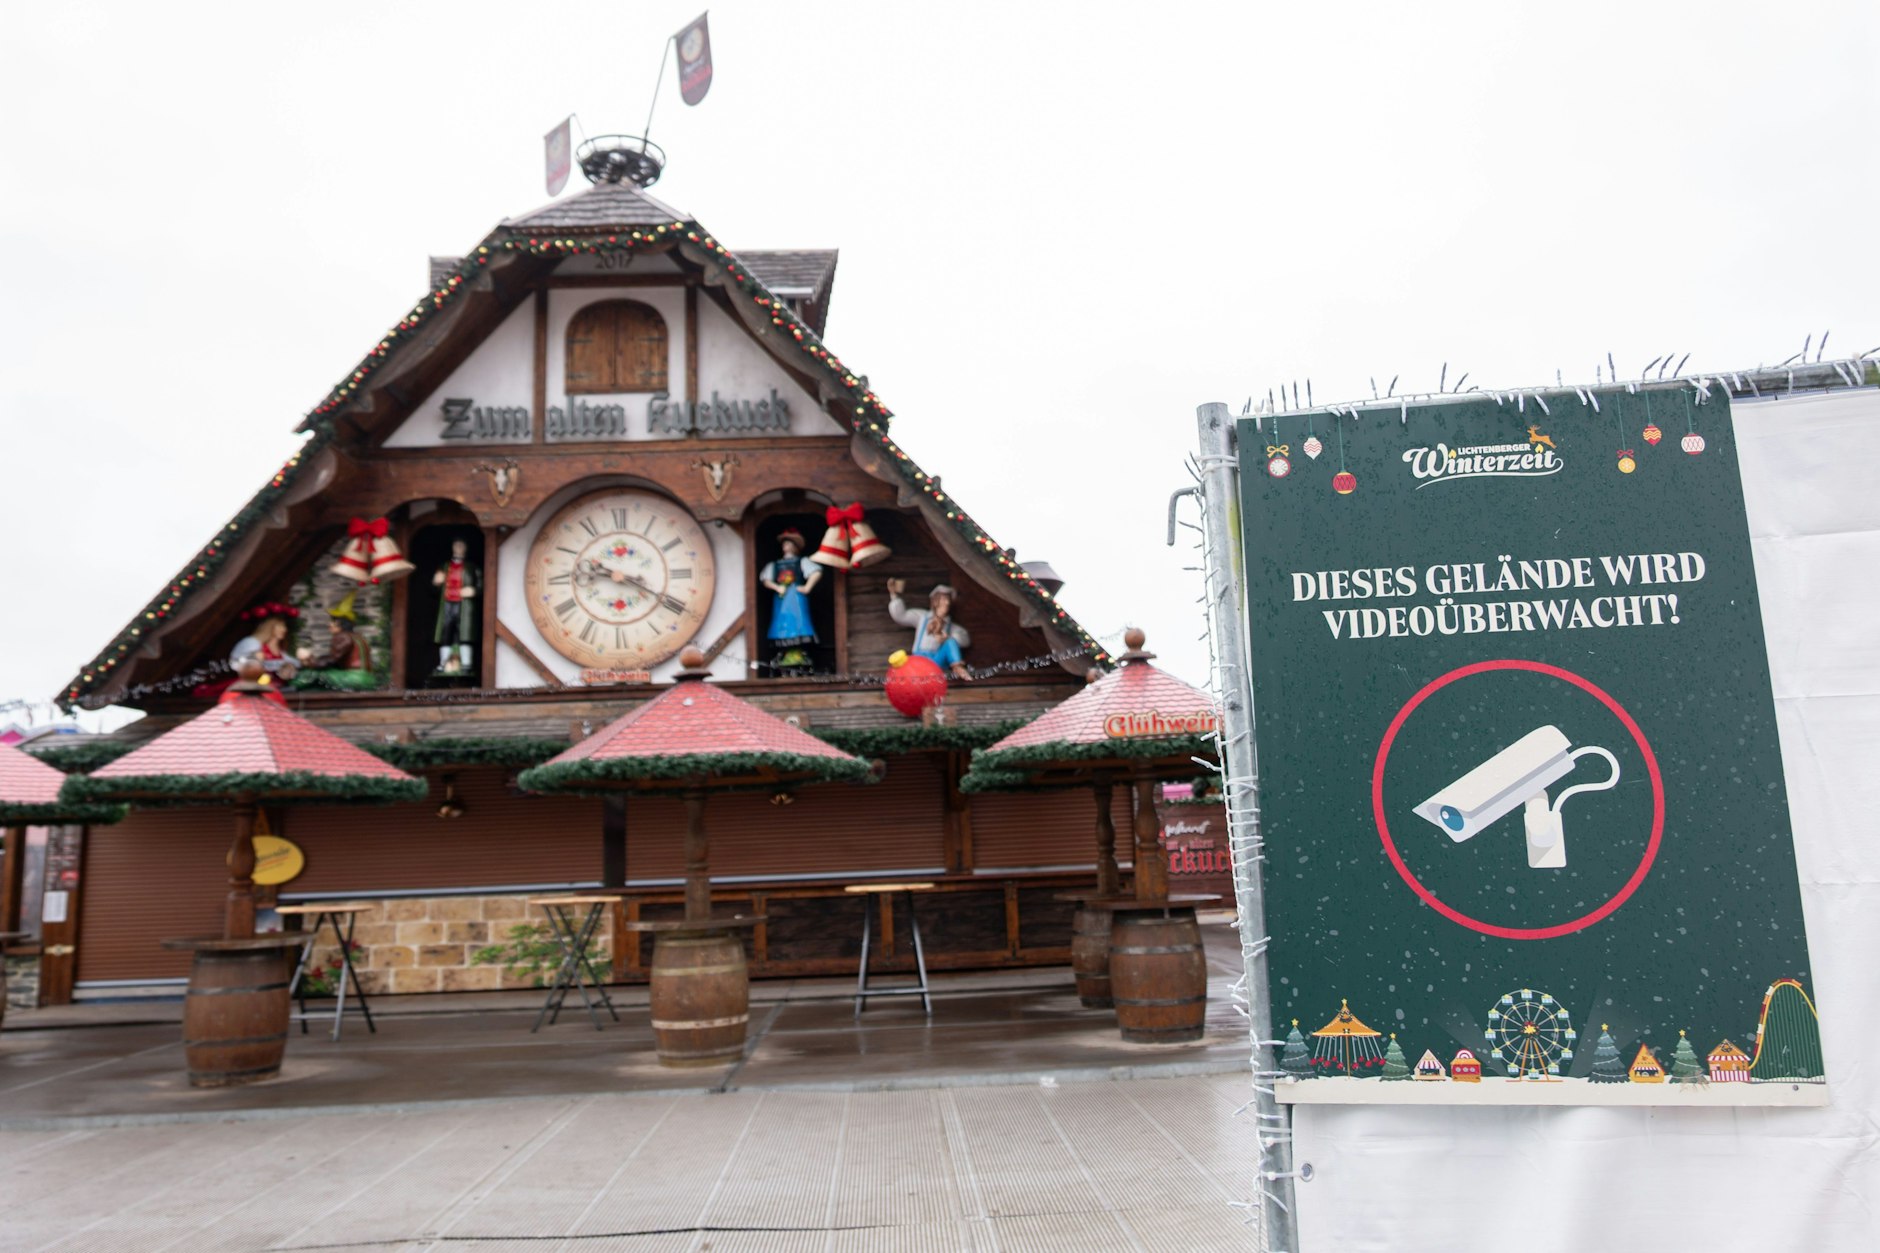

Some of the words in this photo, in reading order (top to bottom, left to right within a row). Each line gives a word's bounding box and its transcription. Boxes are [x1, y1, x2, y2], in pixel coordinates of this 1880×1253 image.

[439, 397, 530, 439] Zum
[547, 394, 626, 437] alten
[647, 388, 791, 433] Kuckuck
[1402, 443, 1563, 480] Winterzeit
[1458, 443, 1531, 455] LICHTENBERGER
[1291, 566, 1417, 601] DIESES
[1425, 554, 1595, 595] GELÄNDE
[1599, 552, 1706, 586] WIRD
[1322, 593, 1681, 640] VIDEOÜBERWACHT!
